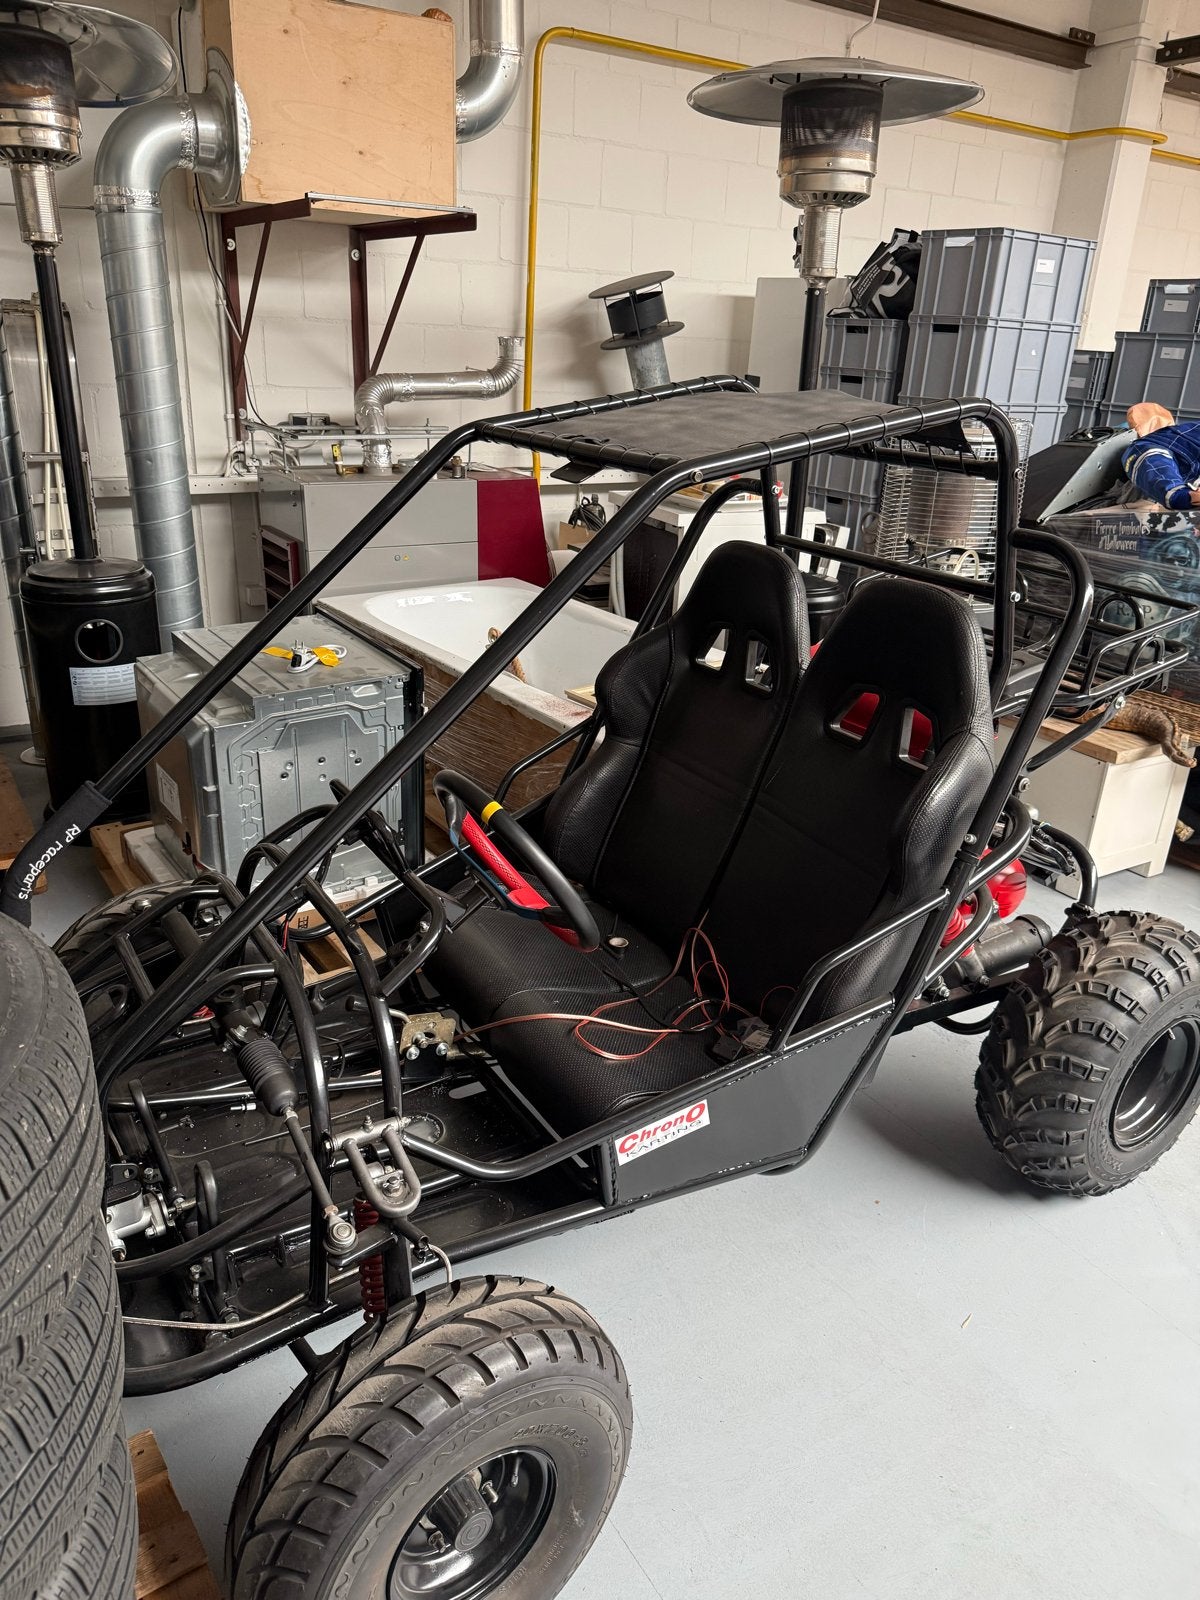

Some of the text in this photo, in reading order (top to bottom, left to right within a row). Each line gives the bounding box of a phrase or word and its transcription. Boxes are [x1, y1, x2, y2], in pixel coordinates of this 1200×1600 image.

[1096, 519, 1117, 535] Pierre
[18, 823, 82, 900] RP raceparts
[626, 1119, 703, 1158] KARTING
